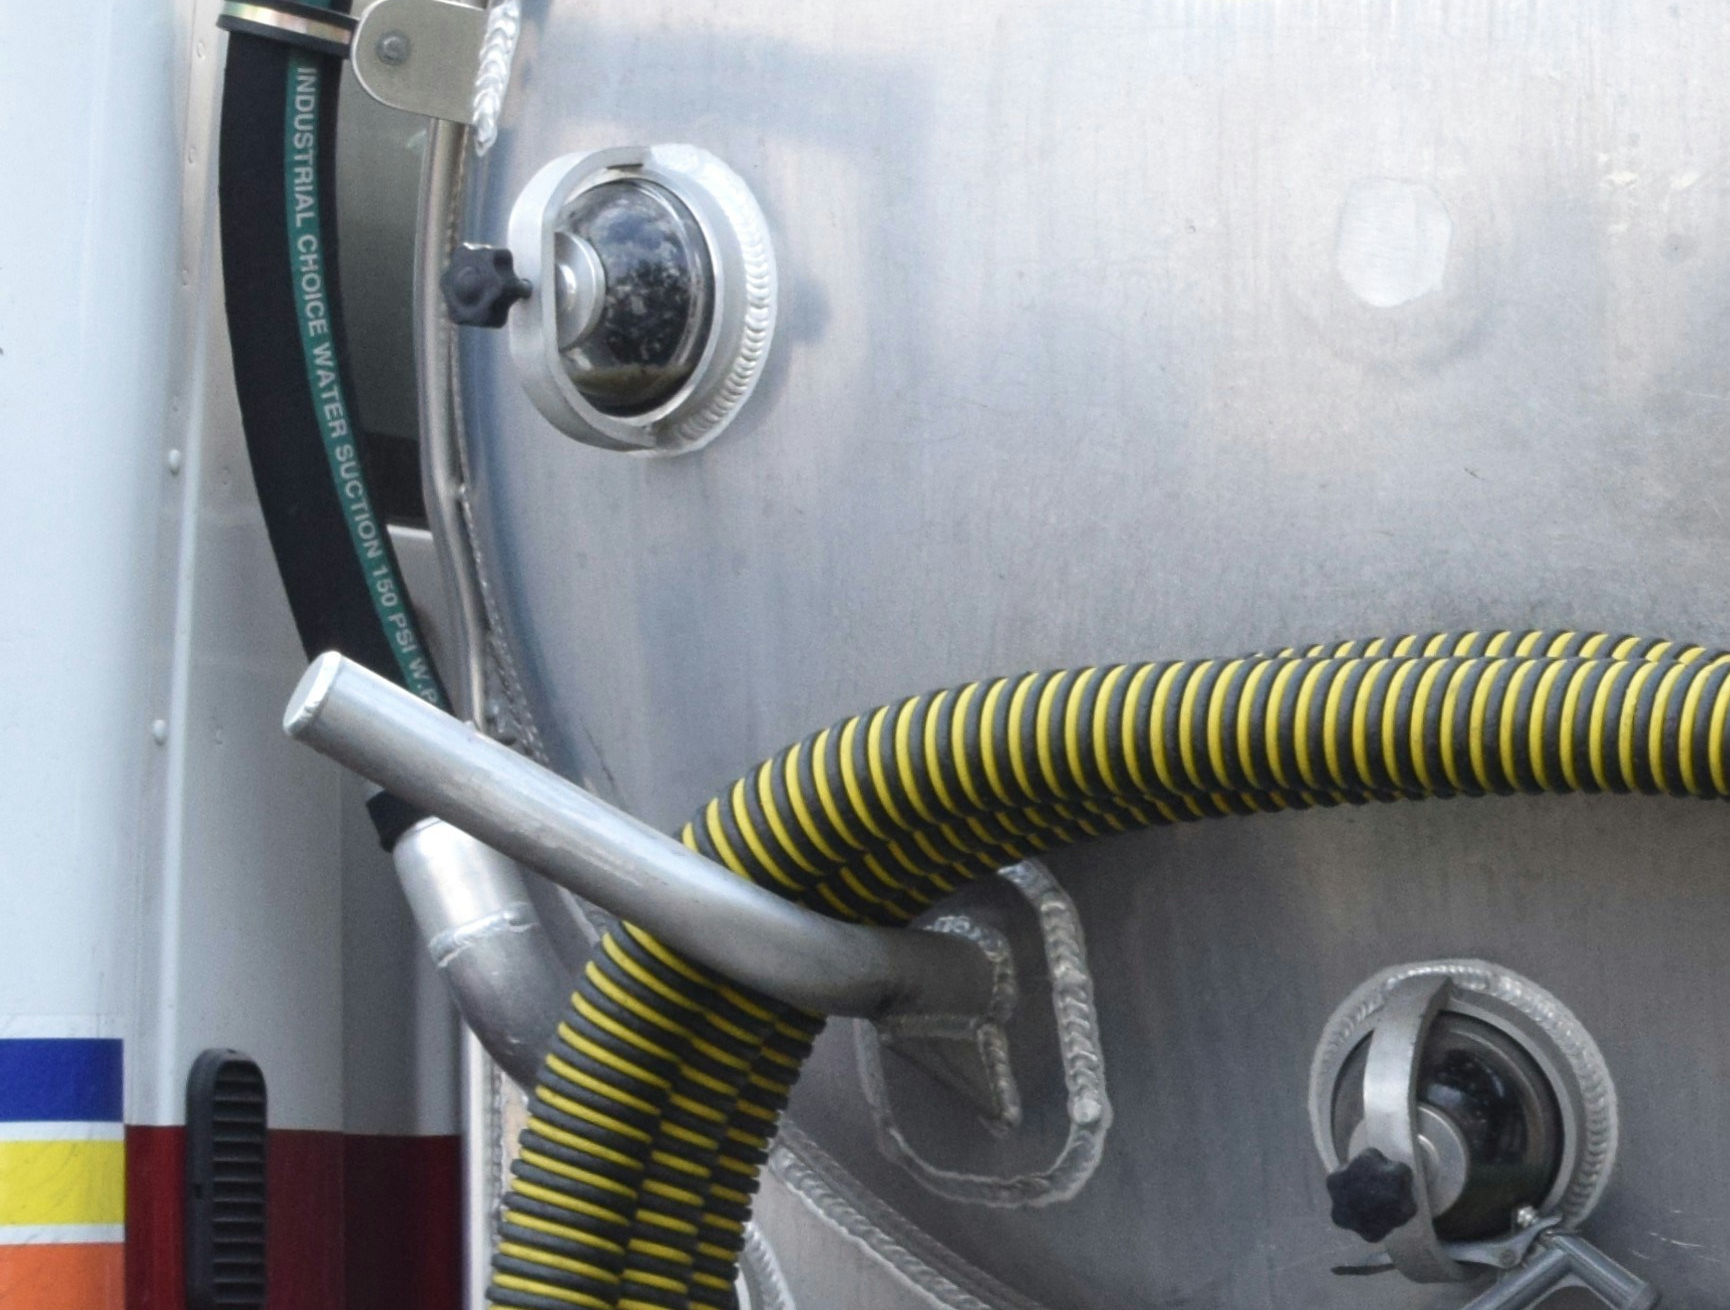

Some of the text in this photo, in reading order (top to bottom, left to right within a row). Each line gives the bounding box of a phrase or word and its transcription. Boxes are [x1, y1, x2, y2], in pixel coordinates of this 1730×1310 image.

[293, 67, 317, 227] INDUSTRIAL
[297, 234, 328, 337] CHOICE
[312, 345, 348, 439] WATER
[335, 445, 383, 558] SUCTION
[372, 566, 397, 607] 150
[389, 614, 418, 654] PSI
